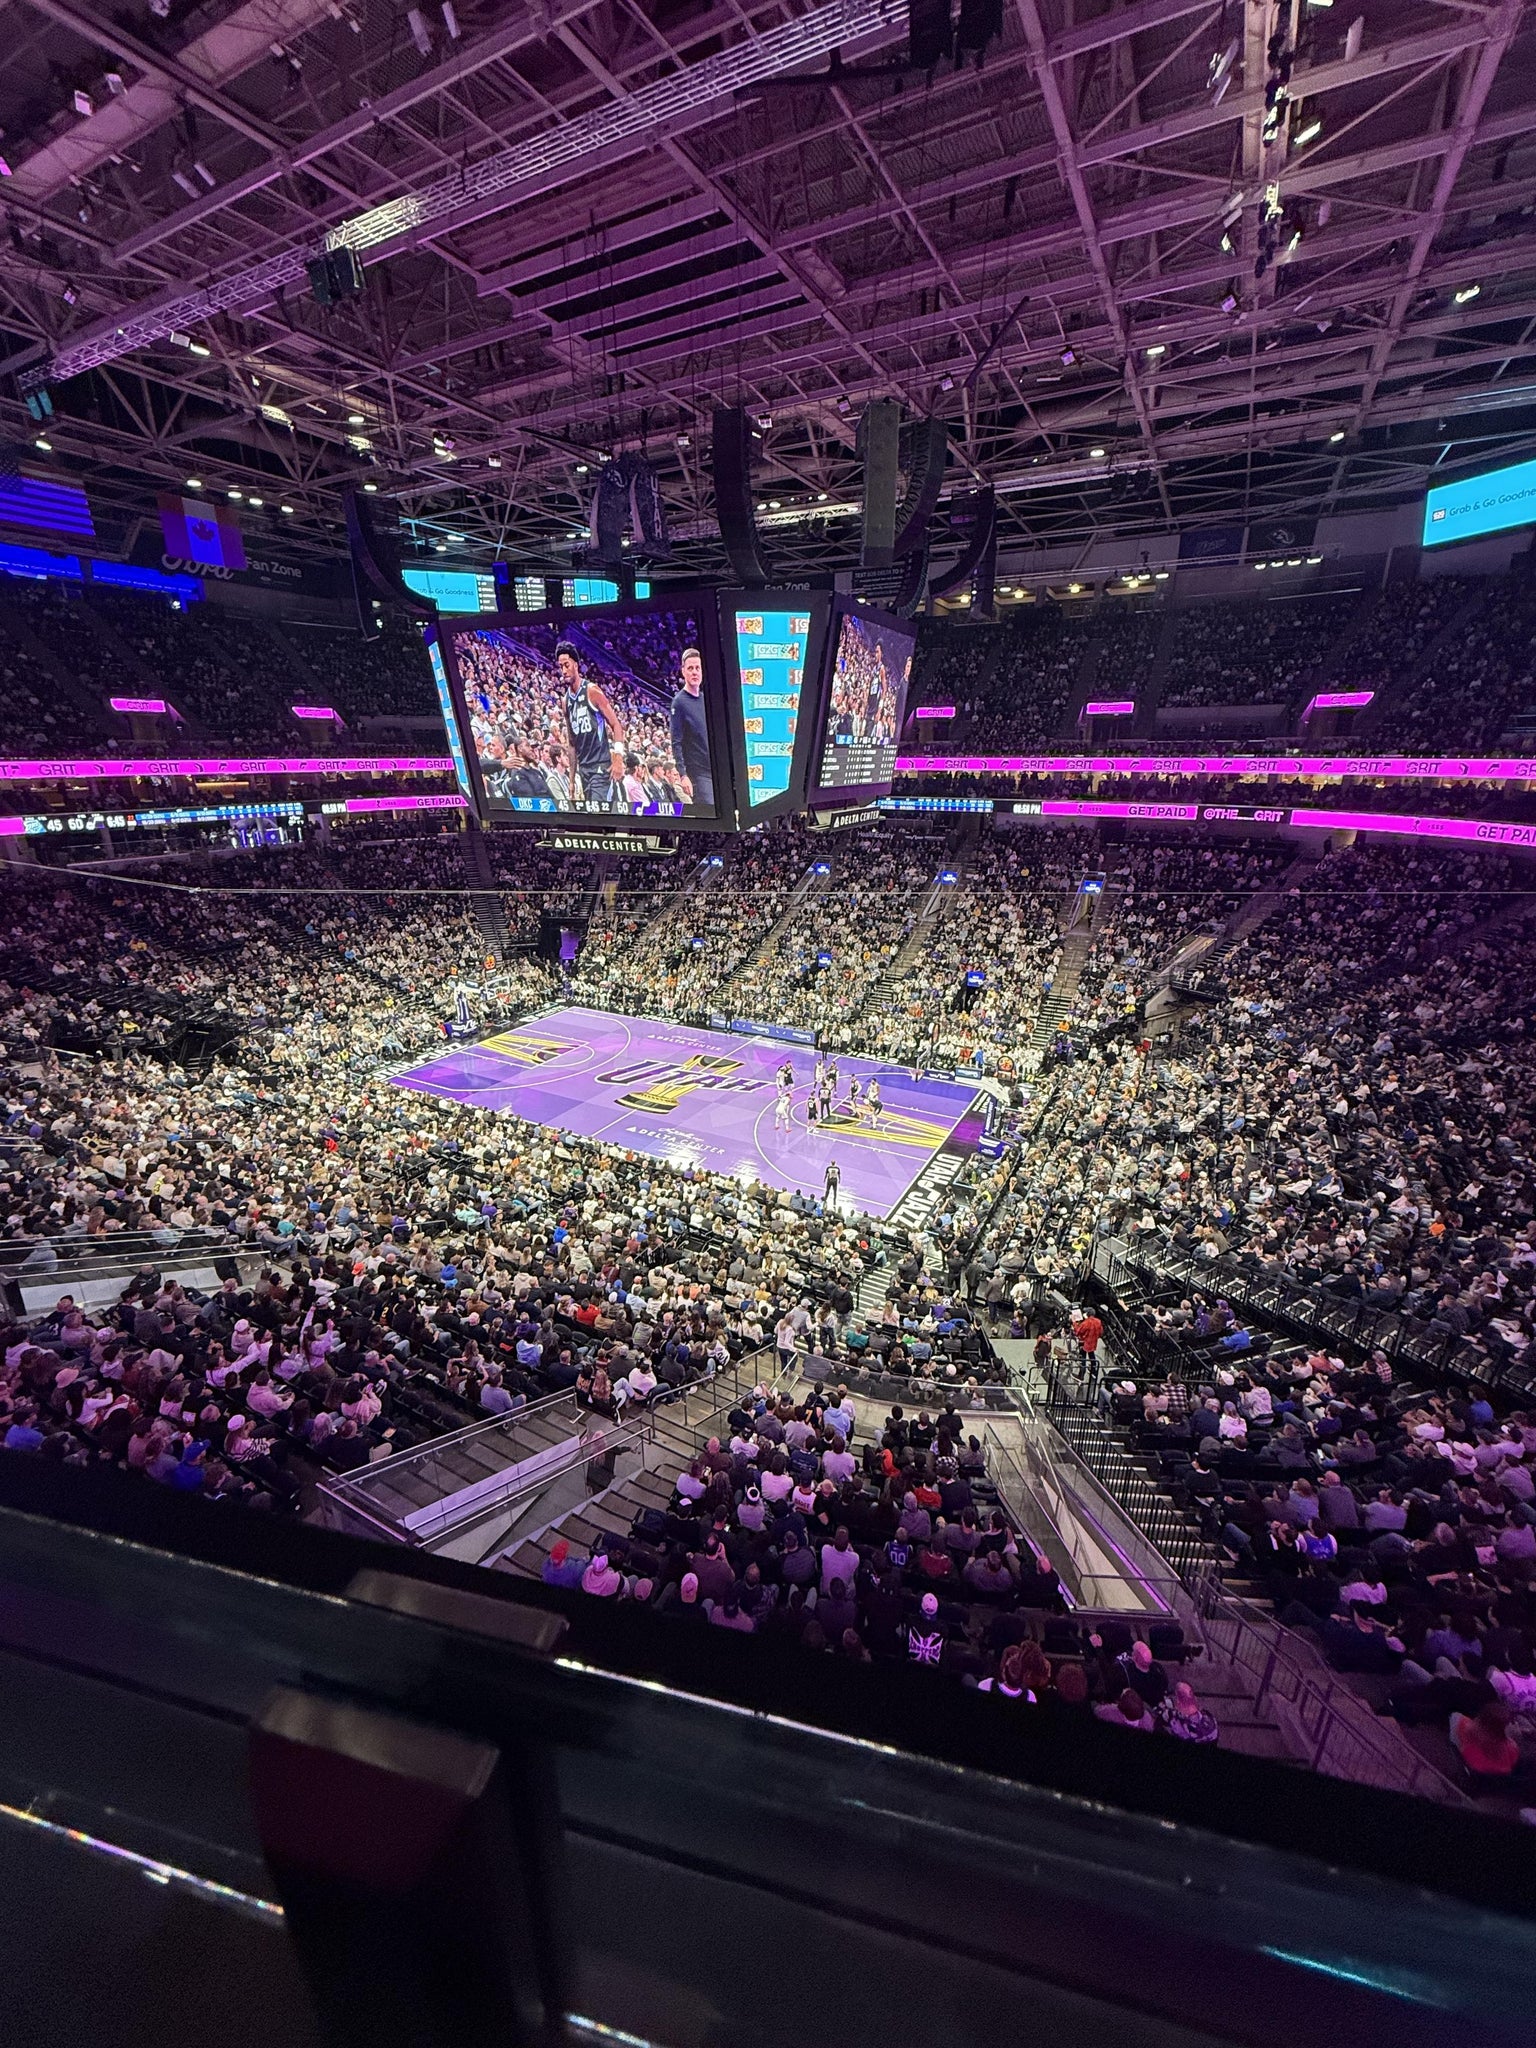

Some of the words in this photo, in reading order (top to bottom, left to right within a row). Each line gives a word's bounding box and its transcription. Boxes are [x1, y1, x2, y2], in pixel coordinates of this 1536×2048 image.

[1449, 504, 1471, 516] Grab
[1473, 502, 1480, 511] &
[1483, 498, 1496, 508] Go
[1498, 488, 1536, 504] Goodne
[270, 561, 302, 577] Zone
[445, 588, 475, 596] Goodness
[580, 716, 592, 733] 28
[39, 764, 76, 776] GRIT
[149, 763, 180, 774] GRIT
[240, 762, 267, 772] GRIT
[318, 761, 341, 770] GRIT
[357, 761, 380, 769] GRIT
[426, 760, 448, 768] GRIT
[1515, 763, 1536, 777] GR
[417, 798, 435, 807] GET
[438, 797, 462, 806] PAID
[518, 798, 533, 809] OKC
[558, 800, 569, 811] 45
[617, 801, 629, 813] 50
[658, 803, 675, 815] UTA
[840, 814, 859, 826] DELTA
[860, 810, 880, 822] CENTER
[1129, 806, 1154, 816] GET
[1156, 806, 1187, 818] PAID
[47, 819, 63, 831] 45
[1477, 825, 1508, 840] GET
[1511, 828, 1536, 843] PAI
[565, 838, 600, 850] DELTA
[602, 840, 644, 852] CENTER
[594, 1060, 772, 1093] UTAH
[638, 1128, 676, 1143] DELTA
[680, 1139, 725, 1155] CENTER
[926, 1153, 965, 1186] UTAH
